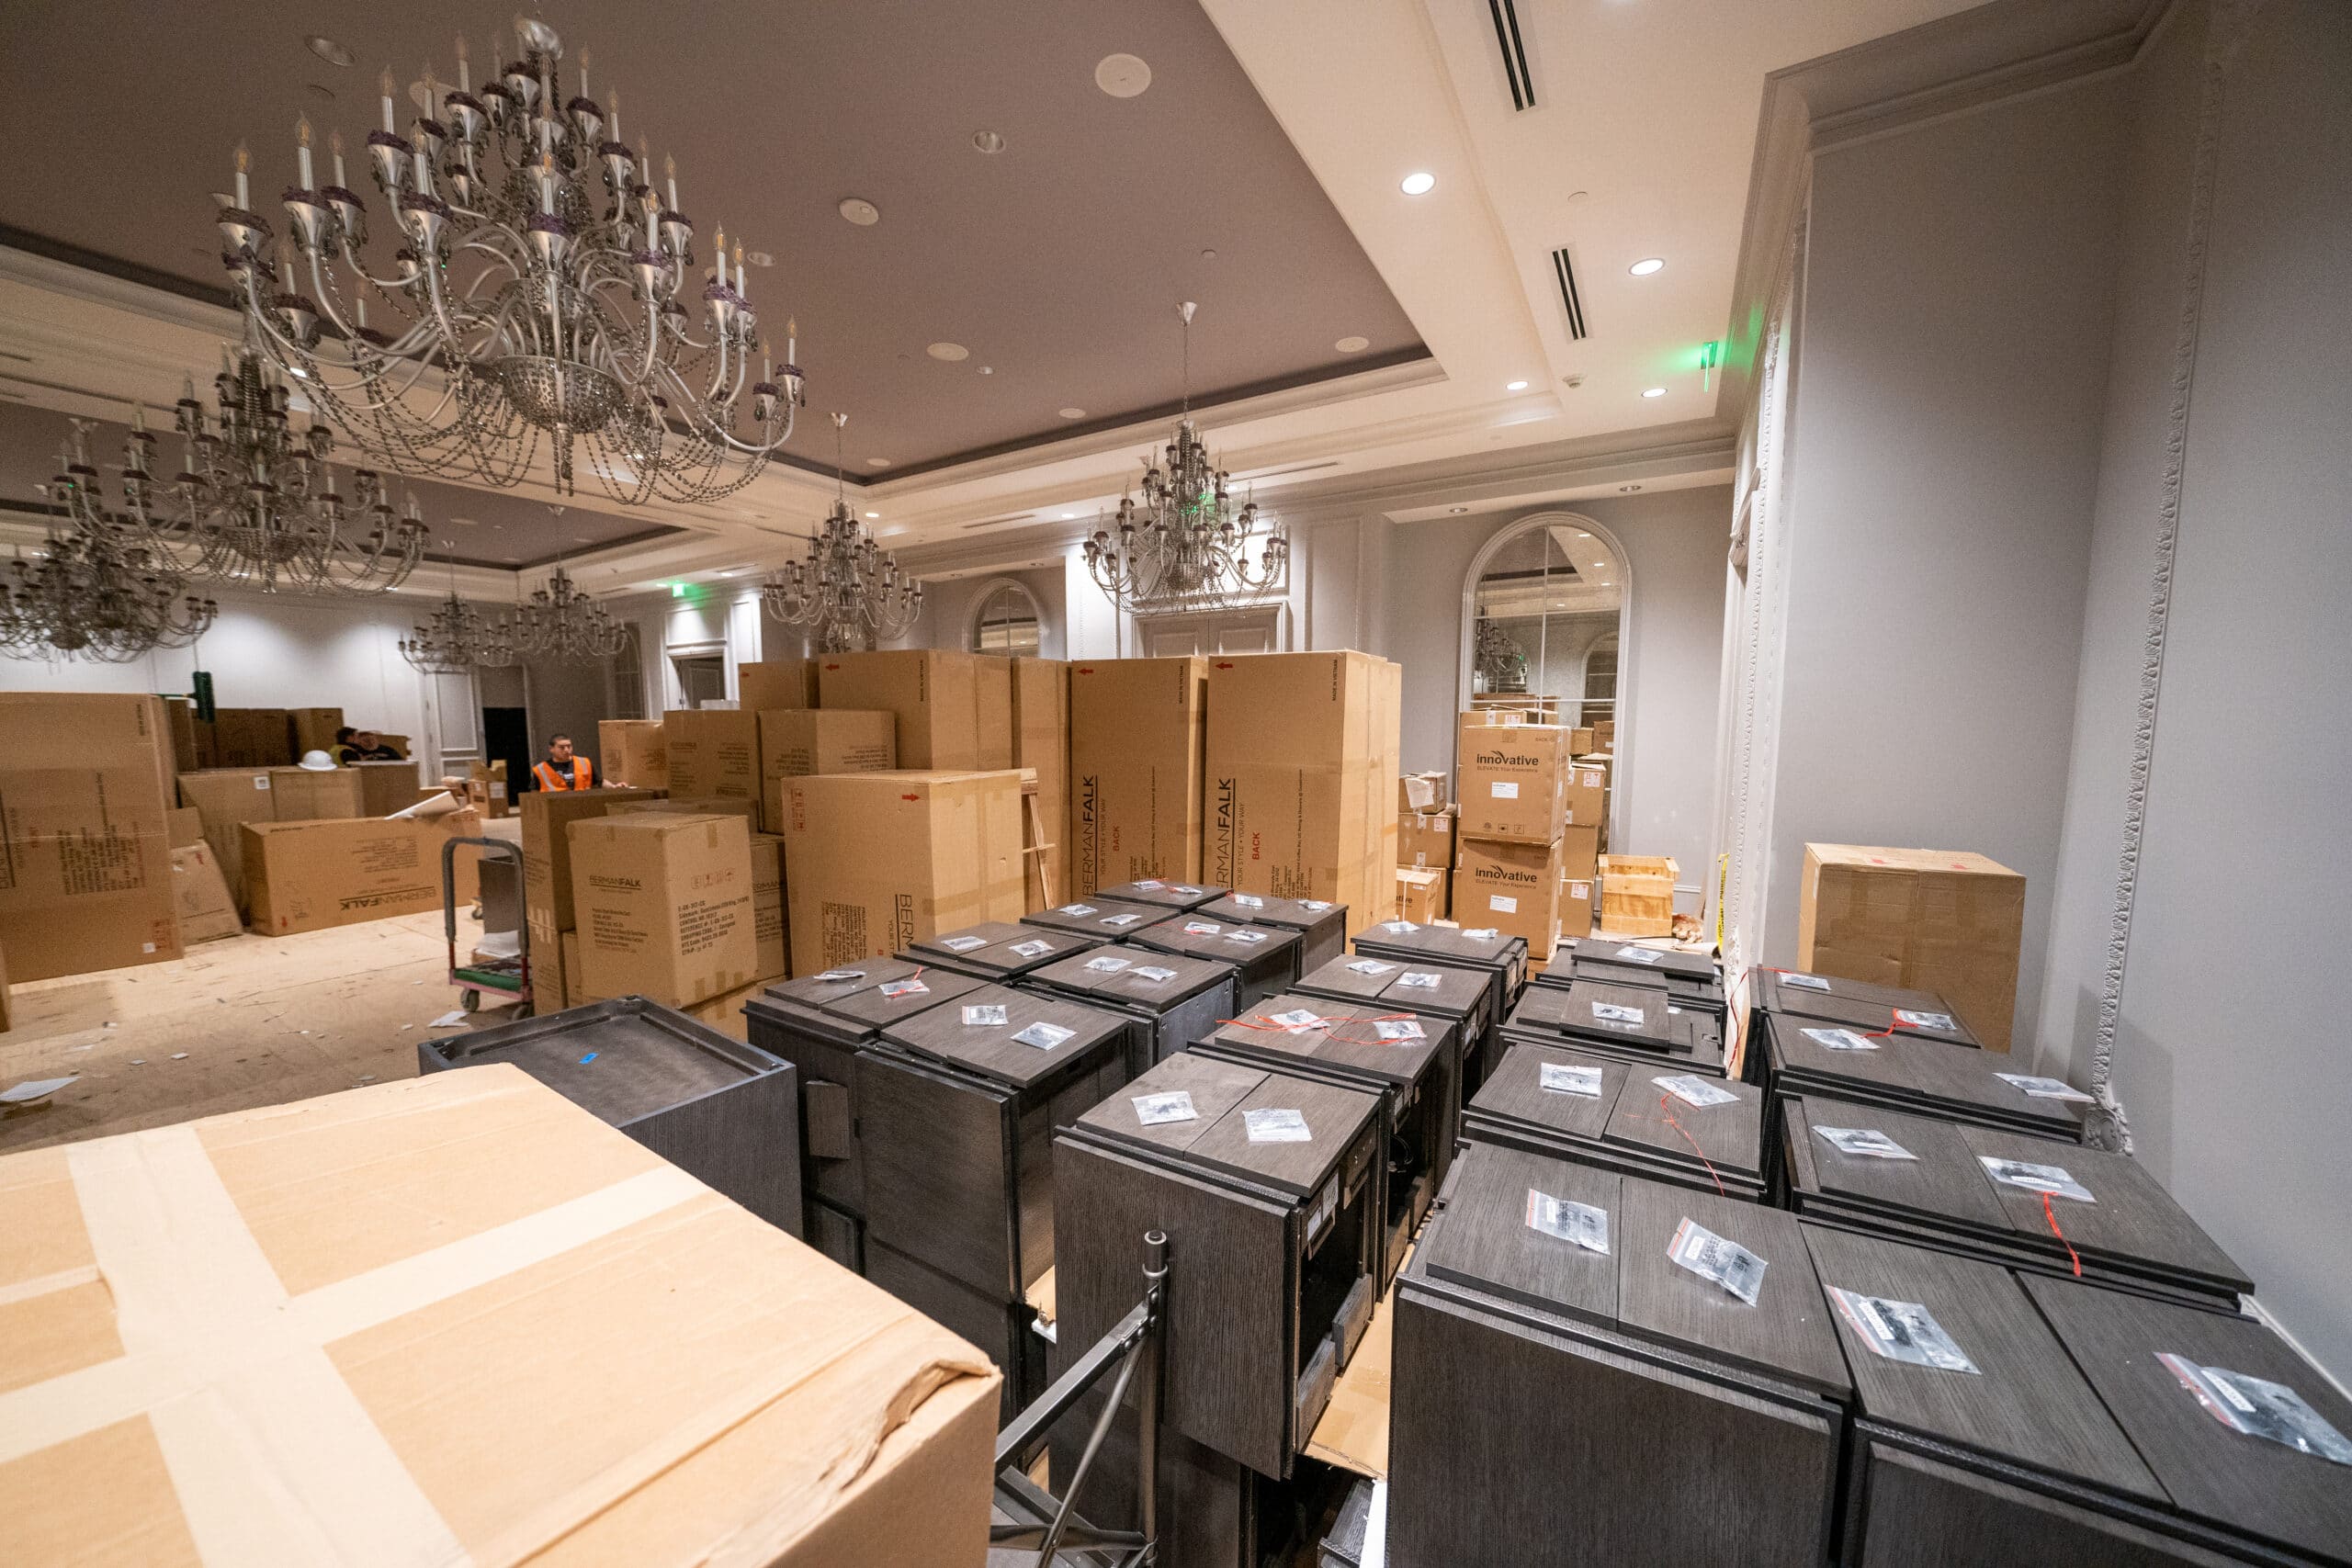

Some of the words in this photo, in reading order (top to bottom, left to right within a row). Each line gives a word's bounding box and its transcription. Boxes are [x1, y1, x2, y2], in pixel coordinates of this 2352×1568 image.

[1081, 774, 1094, 897] BERMANFALK
[1216, 778, 1231, 889] ERMANFALK
[1251, 832, 1260, 860] BACK
[341, 888, 435, 910] BERMANFALK
[589, 875, 641, 887] BERMANFALK
[899, 895, 913, 950] BERM
